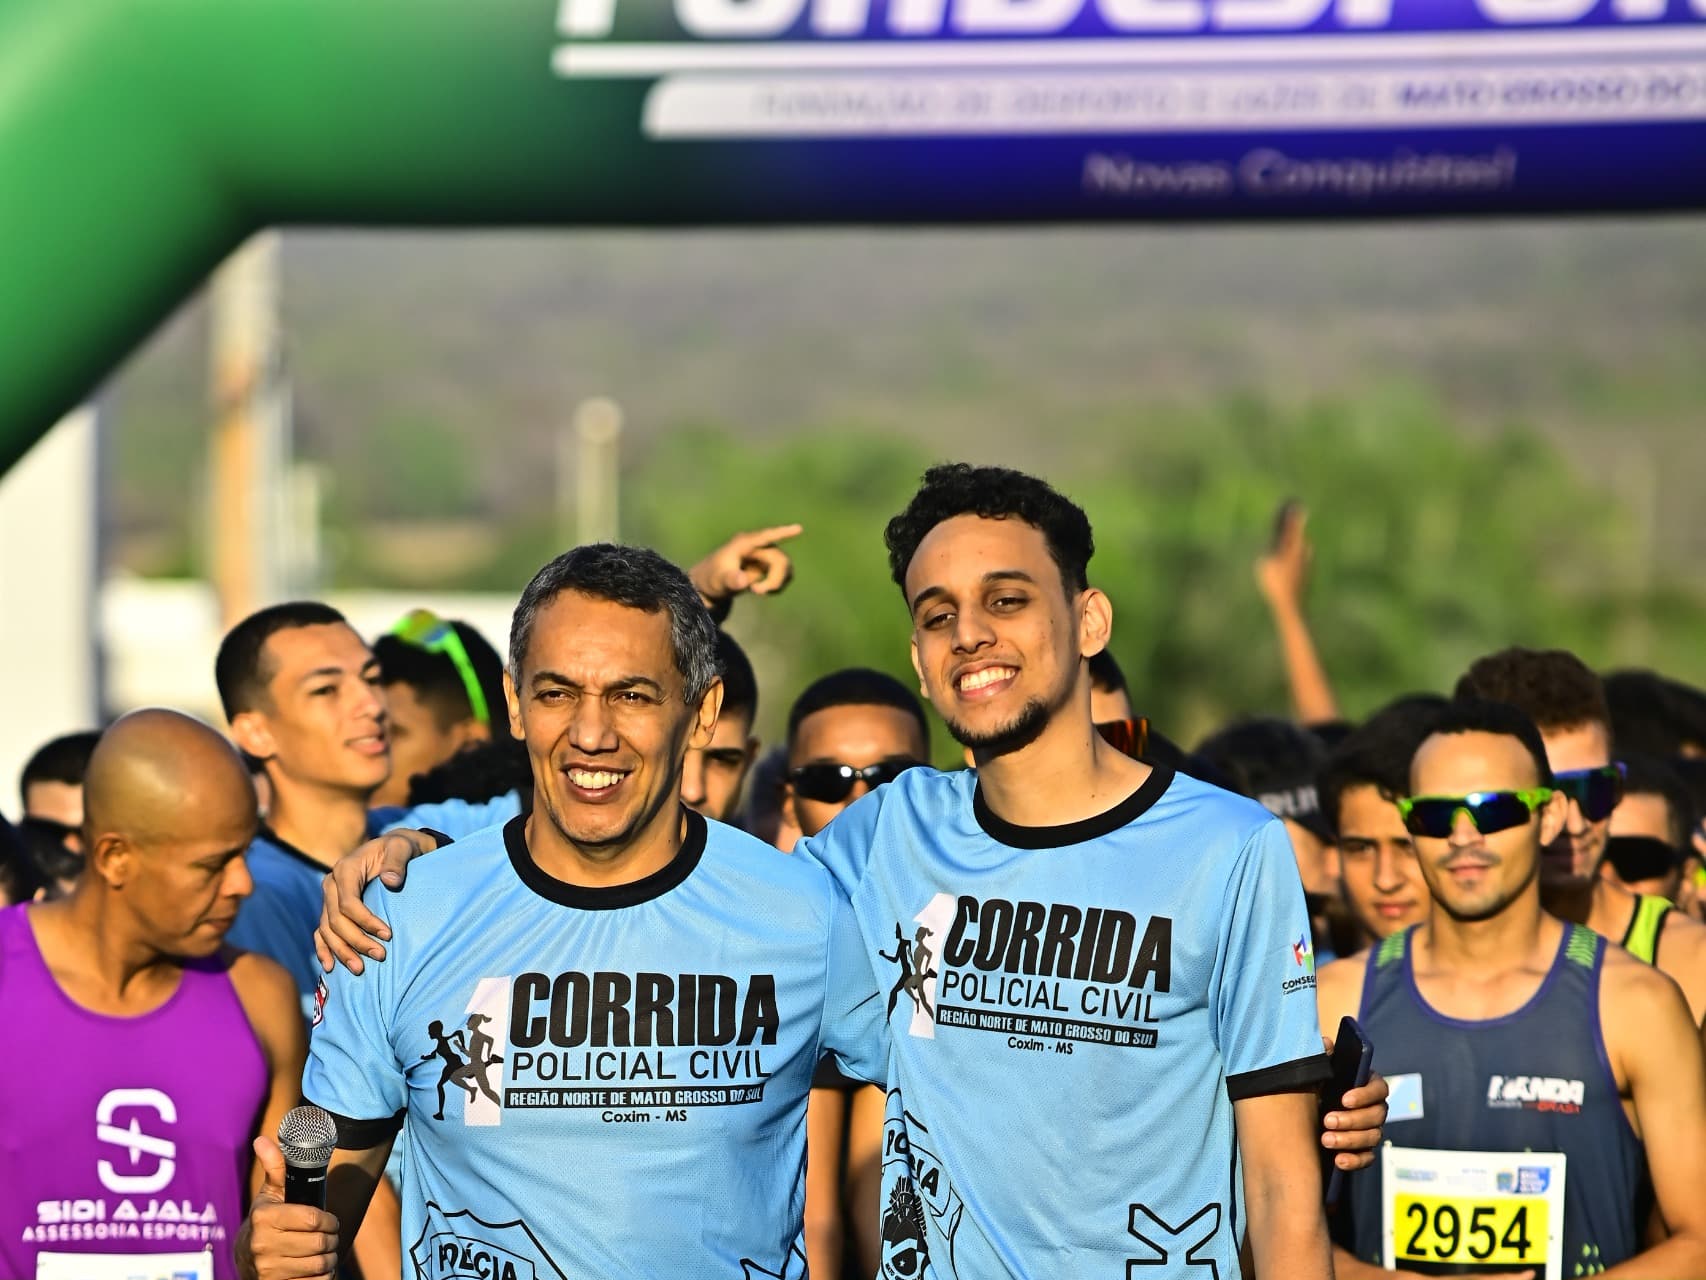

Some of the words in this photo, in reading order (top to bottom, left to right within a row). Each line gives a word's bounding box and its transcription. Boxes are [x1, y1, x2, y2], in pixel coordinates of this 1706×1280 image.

[944, 895, 1172, 993] CORRIDA
[509, 972, 779, 1047] CORRIDA
[942, 970, 1068, 1012] POLICIAL
[1081, 986, 1160, 1023] CIVIL
[940, 1009, 976, 1027] REGIÃO
[979, 1014, 1013, 1030] NORTE
[1015, 1018, 1028, 1032] DE
[1031, 1019, 1061, 1036] MATO
[1065, 1024, 1111, 1042] GROSSO
[1114, 1030, 1130, 1044] DO
[1133, 1032, 1155, 1046] SUL
[1007, 1036, 1044, 1051] Coxim
[1055, 1041, 1074, 1055] MS
[512, 1051, 677, 1081] POLICIAL
[690, 1049, 772, 1079] CIVIL
[510, 1090, 559, 1107] REGIÃO
[562, 1091, 607, 1106] NORTE
[610, 1090, 627, 1106] DE
[630, 1090, 671, 1105] MATO
[675, 1089, 726, 1104] GROSSO
[729, 1088, 744, 1102] DO
[746, 1088, 762, 1101] SUL
[601, 1110, 650, 1123] Coxim
[665, 1109, 687, 1122] MS
[22, 1223, 141, 1242] ASSESSORIA
[1405, 1202, 1532, 1261] 2954
